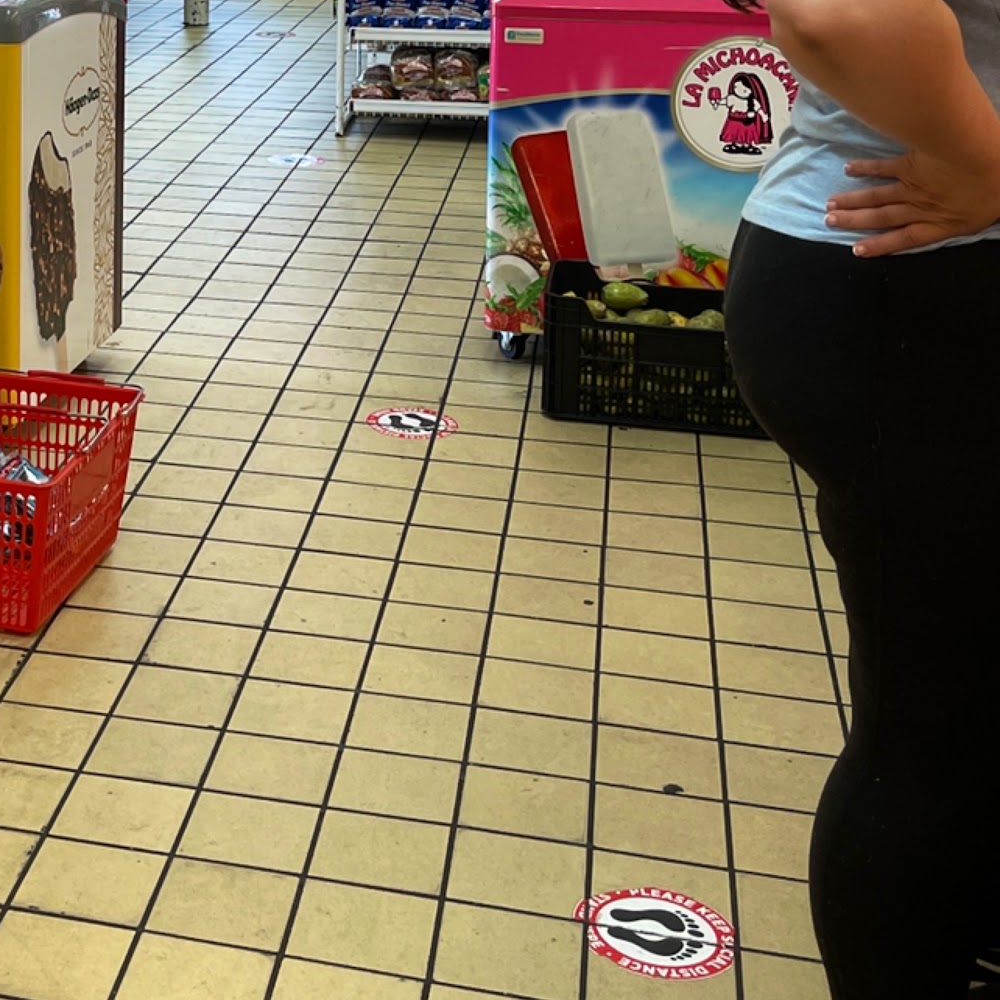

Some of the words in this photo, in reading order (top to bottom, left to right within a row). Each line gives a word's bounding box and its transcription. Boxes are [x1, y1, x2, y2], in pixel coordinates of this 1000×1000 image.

[682, 83, 704, 108] LA
[693, 47, 800, 104] MICHOACAN
[628, 888, 698, 909] PLEASE
[695, 906, 731, 934] KEEP
[617, 957, 710, 979] DISTANCE
